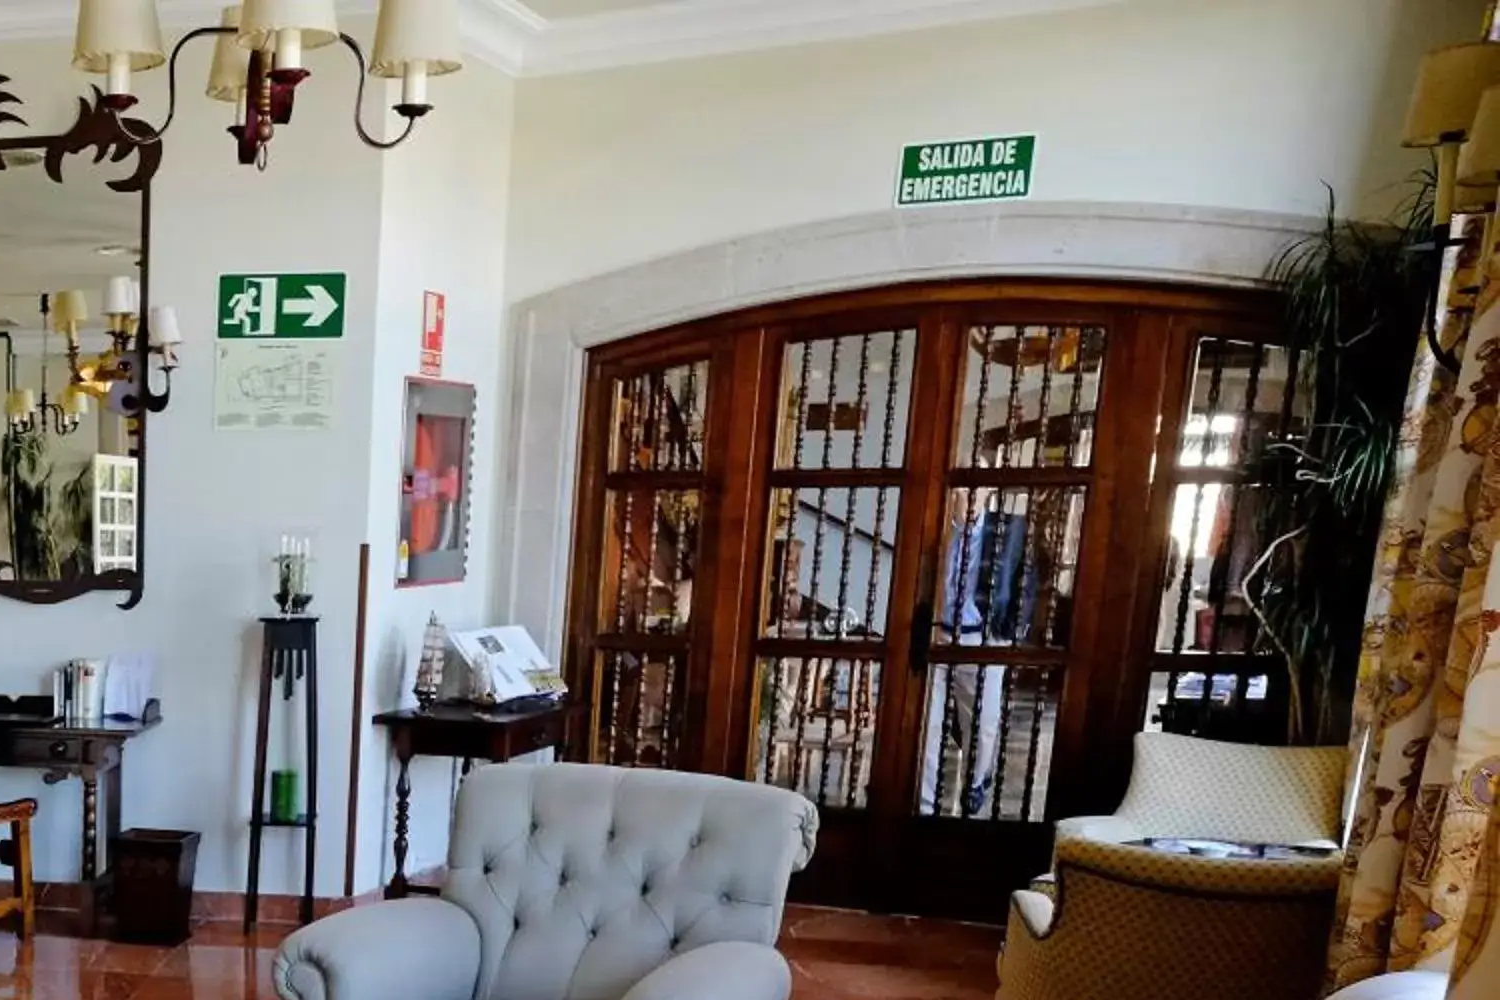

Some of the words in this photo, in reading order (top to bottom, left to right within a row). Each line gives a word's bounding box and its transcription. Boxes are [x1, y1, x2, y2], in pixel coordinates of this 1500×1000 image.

[918, 142, 985, 171] SALIDA
[991, 139, 1018, 165] DE
[901, 169, 1026, 202] EMERGENCIA
